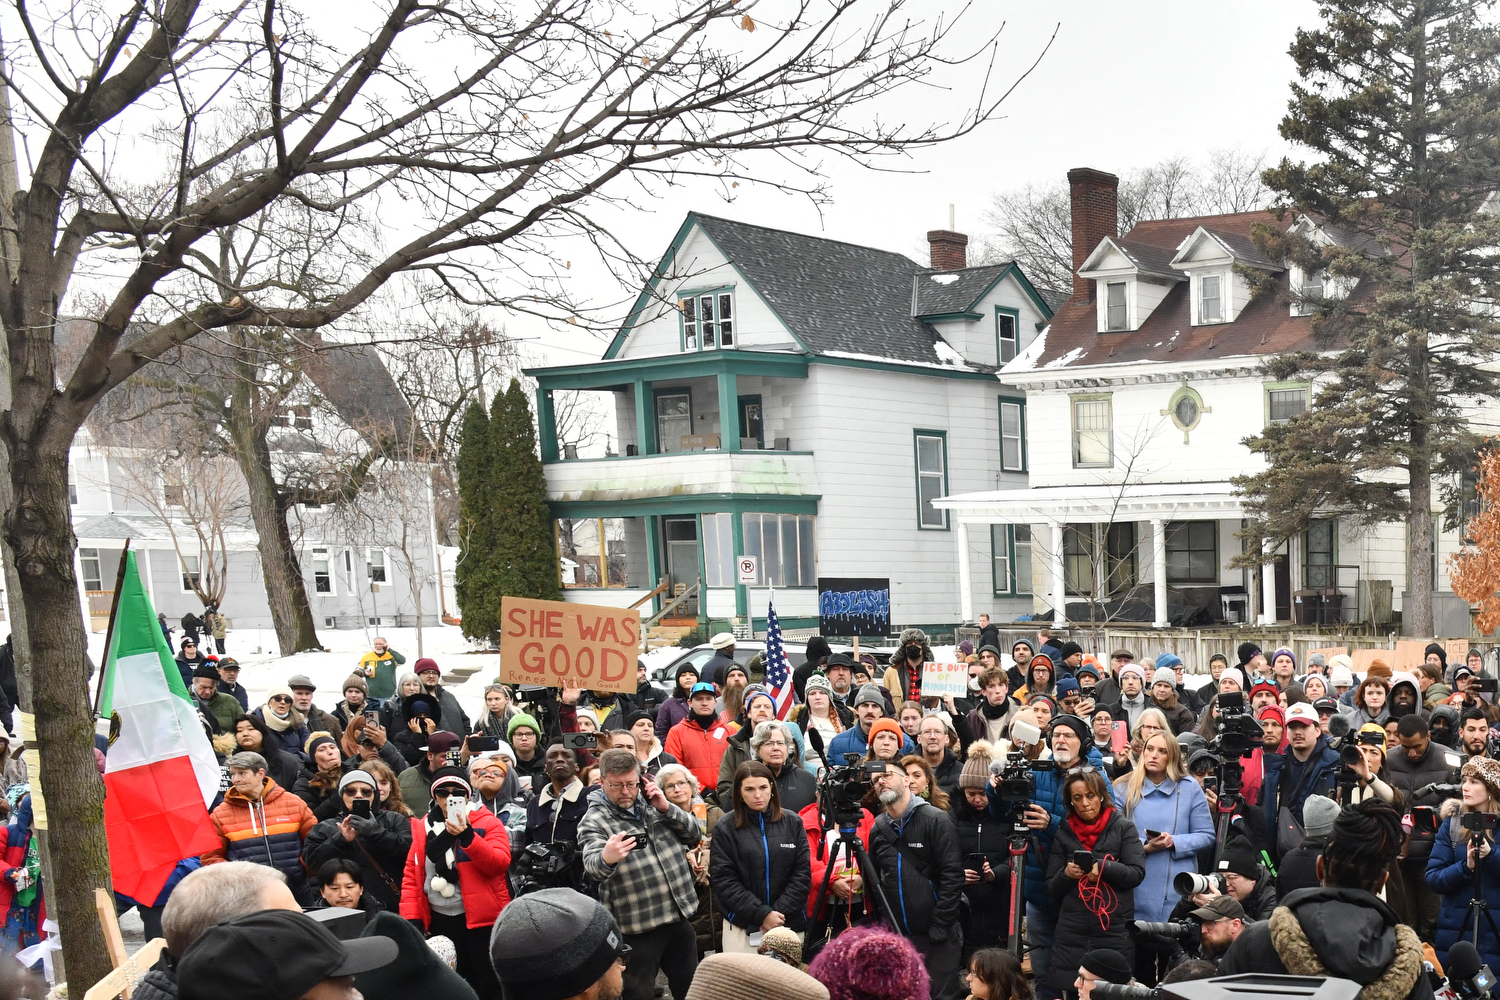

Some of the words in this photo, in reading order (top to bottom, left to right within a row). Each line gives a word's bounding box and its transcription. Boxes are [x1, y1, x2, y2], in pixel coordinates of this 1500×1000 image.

[819, 589, 889, 617] ABOLISH
[507, 608, 563, 638] SHE
[576, 614, 636, 646] WAS
[519, 642, 628, 681] GOOD
[924, 663, 943, 672] ICE
[947, 664, 967, 672] OUT
[509, 670, 535, 684] Renee
[597, 680, 620, 688] Good
[923, 682, 966, 693] MINNESOTA
